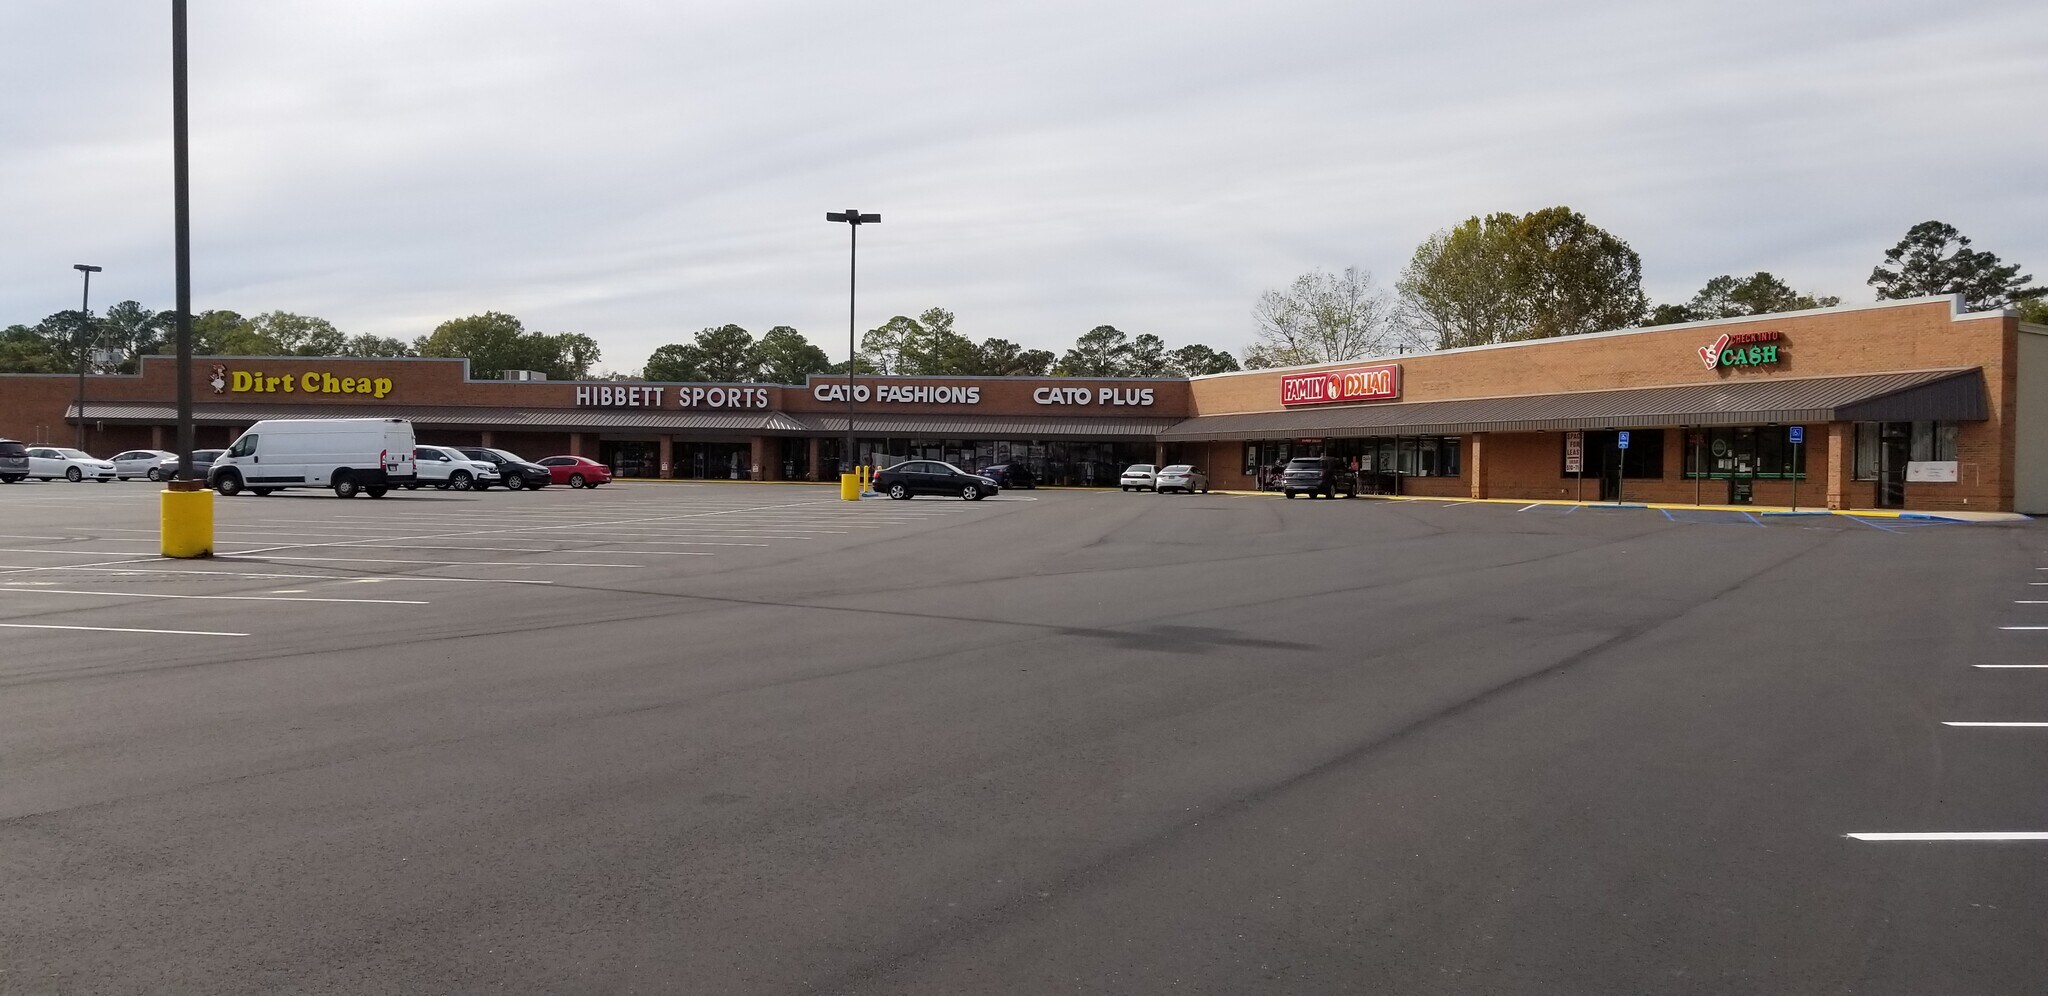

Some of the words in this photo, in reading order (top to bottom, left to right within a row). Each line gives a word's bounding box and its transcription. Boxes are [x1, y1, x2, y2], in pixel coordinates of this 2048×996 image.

[1730, 334, 1756, 344] CHECK
[1758, 331, 1778, 341] INTO
[1721, 345, 1778, 367] CA$H
[231, 371, 295, 392] Dirt
[300, 371, 393, 399] Cheap
[814, 384, 871, 402] CATO
[876, 385, 980, 404] FASHIONS
[1284, 376, 1327, 401] FAMILY
[1344, 369, 1391, 397] DOLLAR
[576, 386, 665, 407] HIBBETT
[679, 387, 769, 408] SPORTS
[1033, 387, 1092, 405] CATO
[1098, 388, 1154, 406] PLUS
